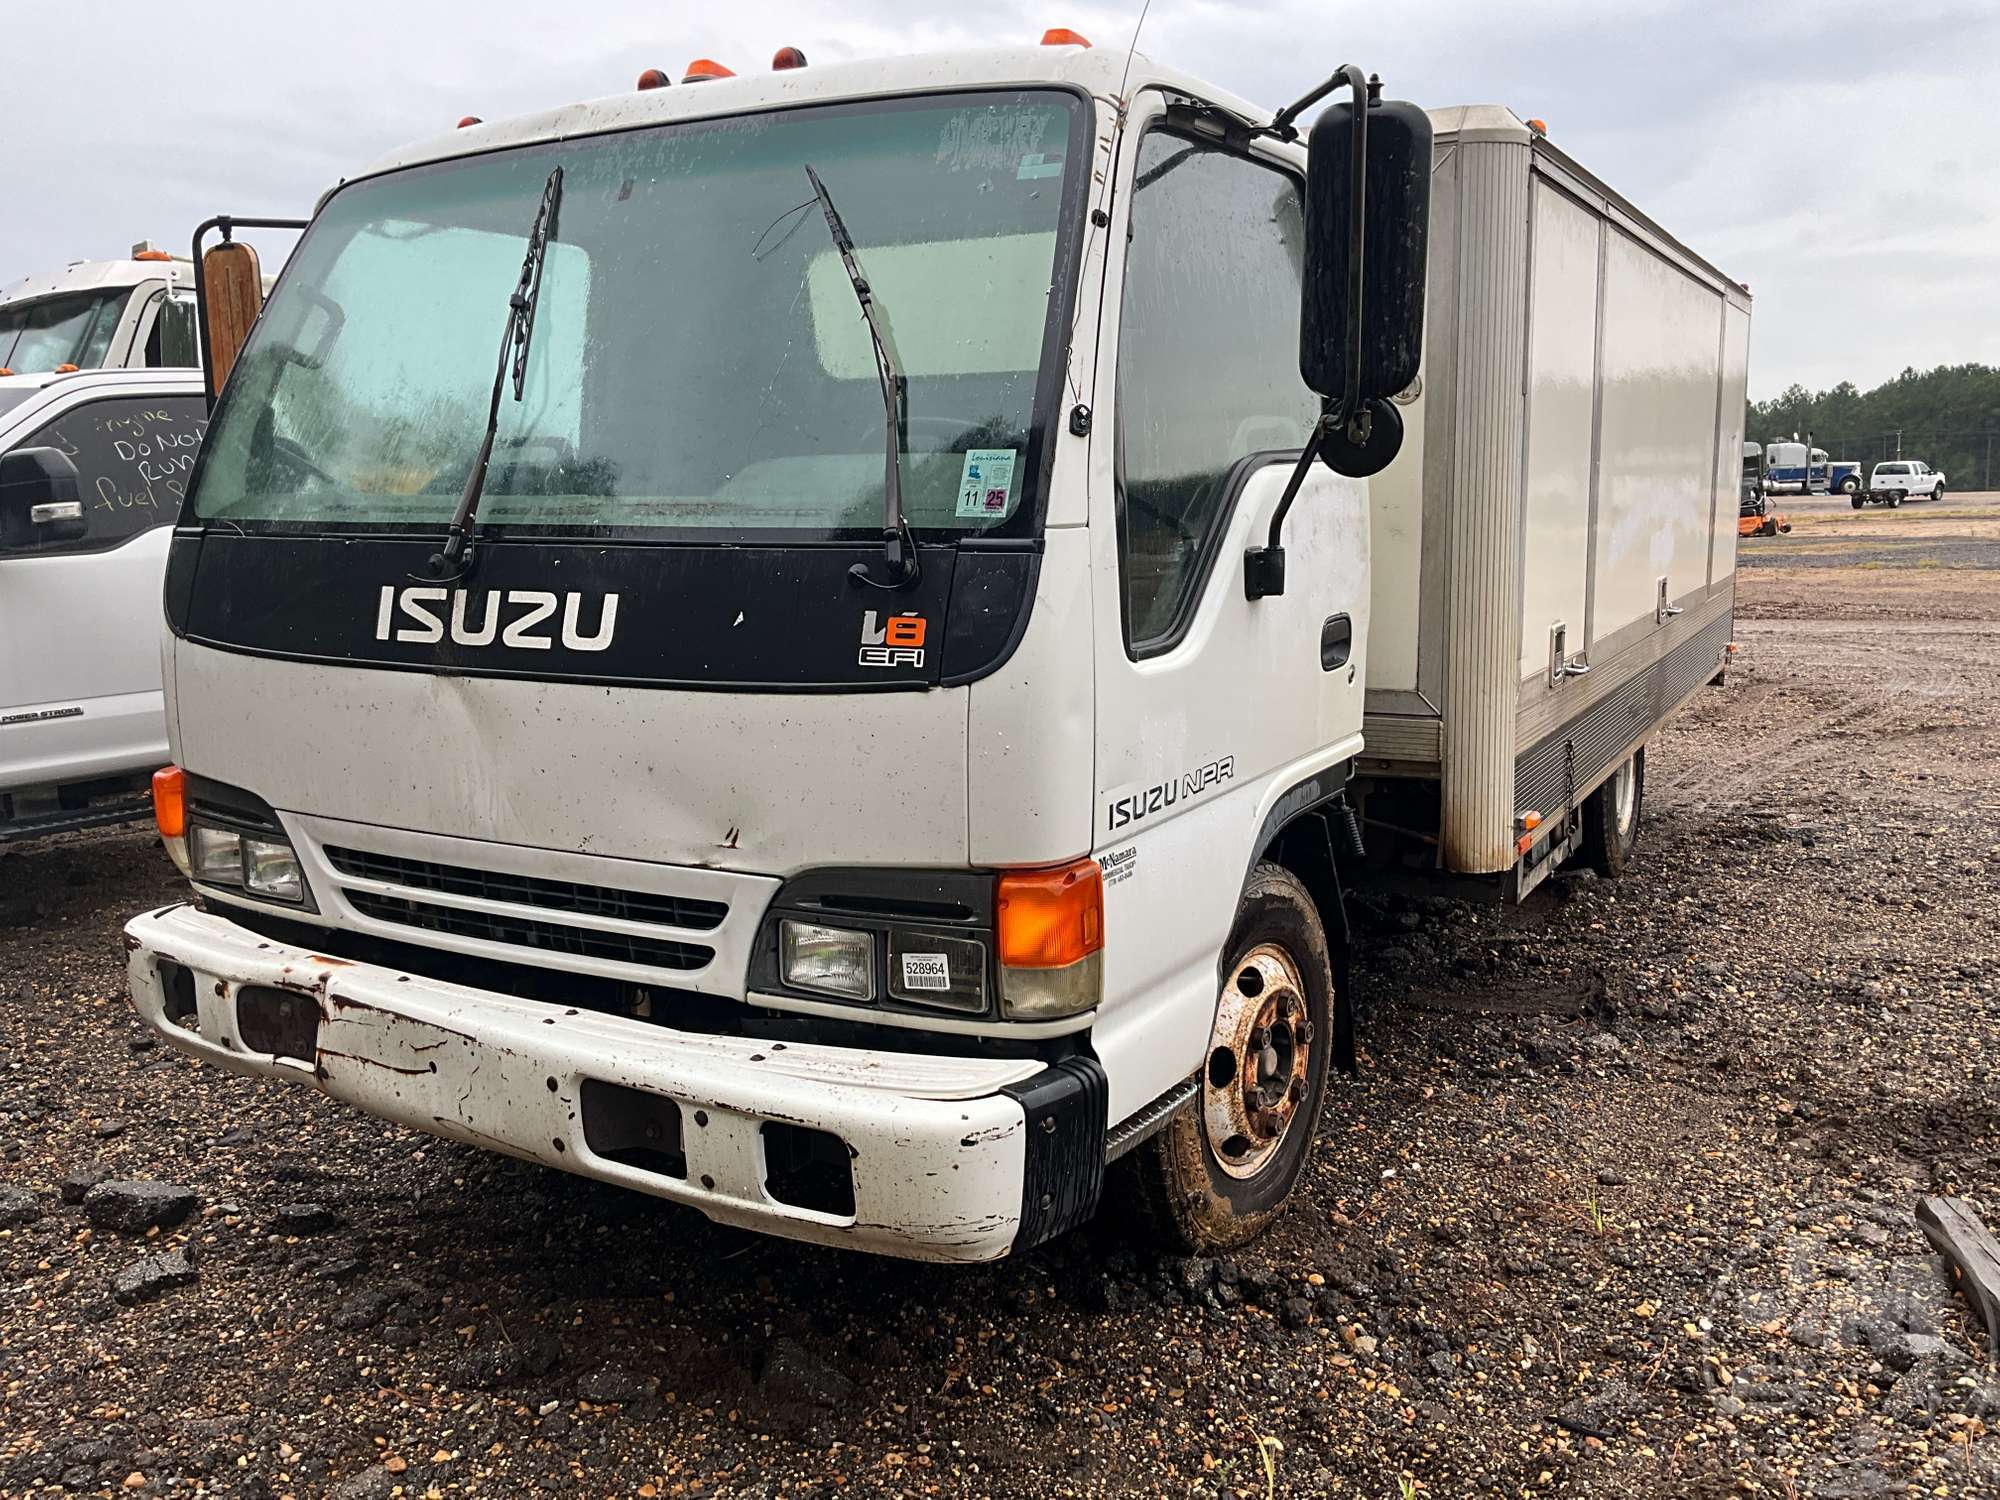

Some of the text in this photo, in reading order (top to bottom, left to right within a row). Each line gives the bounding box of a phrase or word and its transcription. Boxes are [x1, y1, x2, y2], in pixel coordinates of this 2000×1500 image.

[971, 452, 1011, 461] Louisiana
[964, 490, 1004, 506] 11 25
[376, 586, 619, 651] ISUZU
[2, 707, 82, 723] POWER STROKE
[1108, 755, 1234, 831] ISUZU NPR
[1099, 846, 1137, 870] McNamara
[906, 962, 944, 975] 528964
